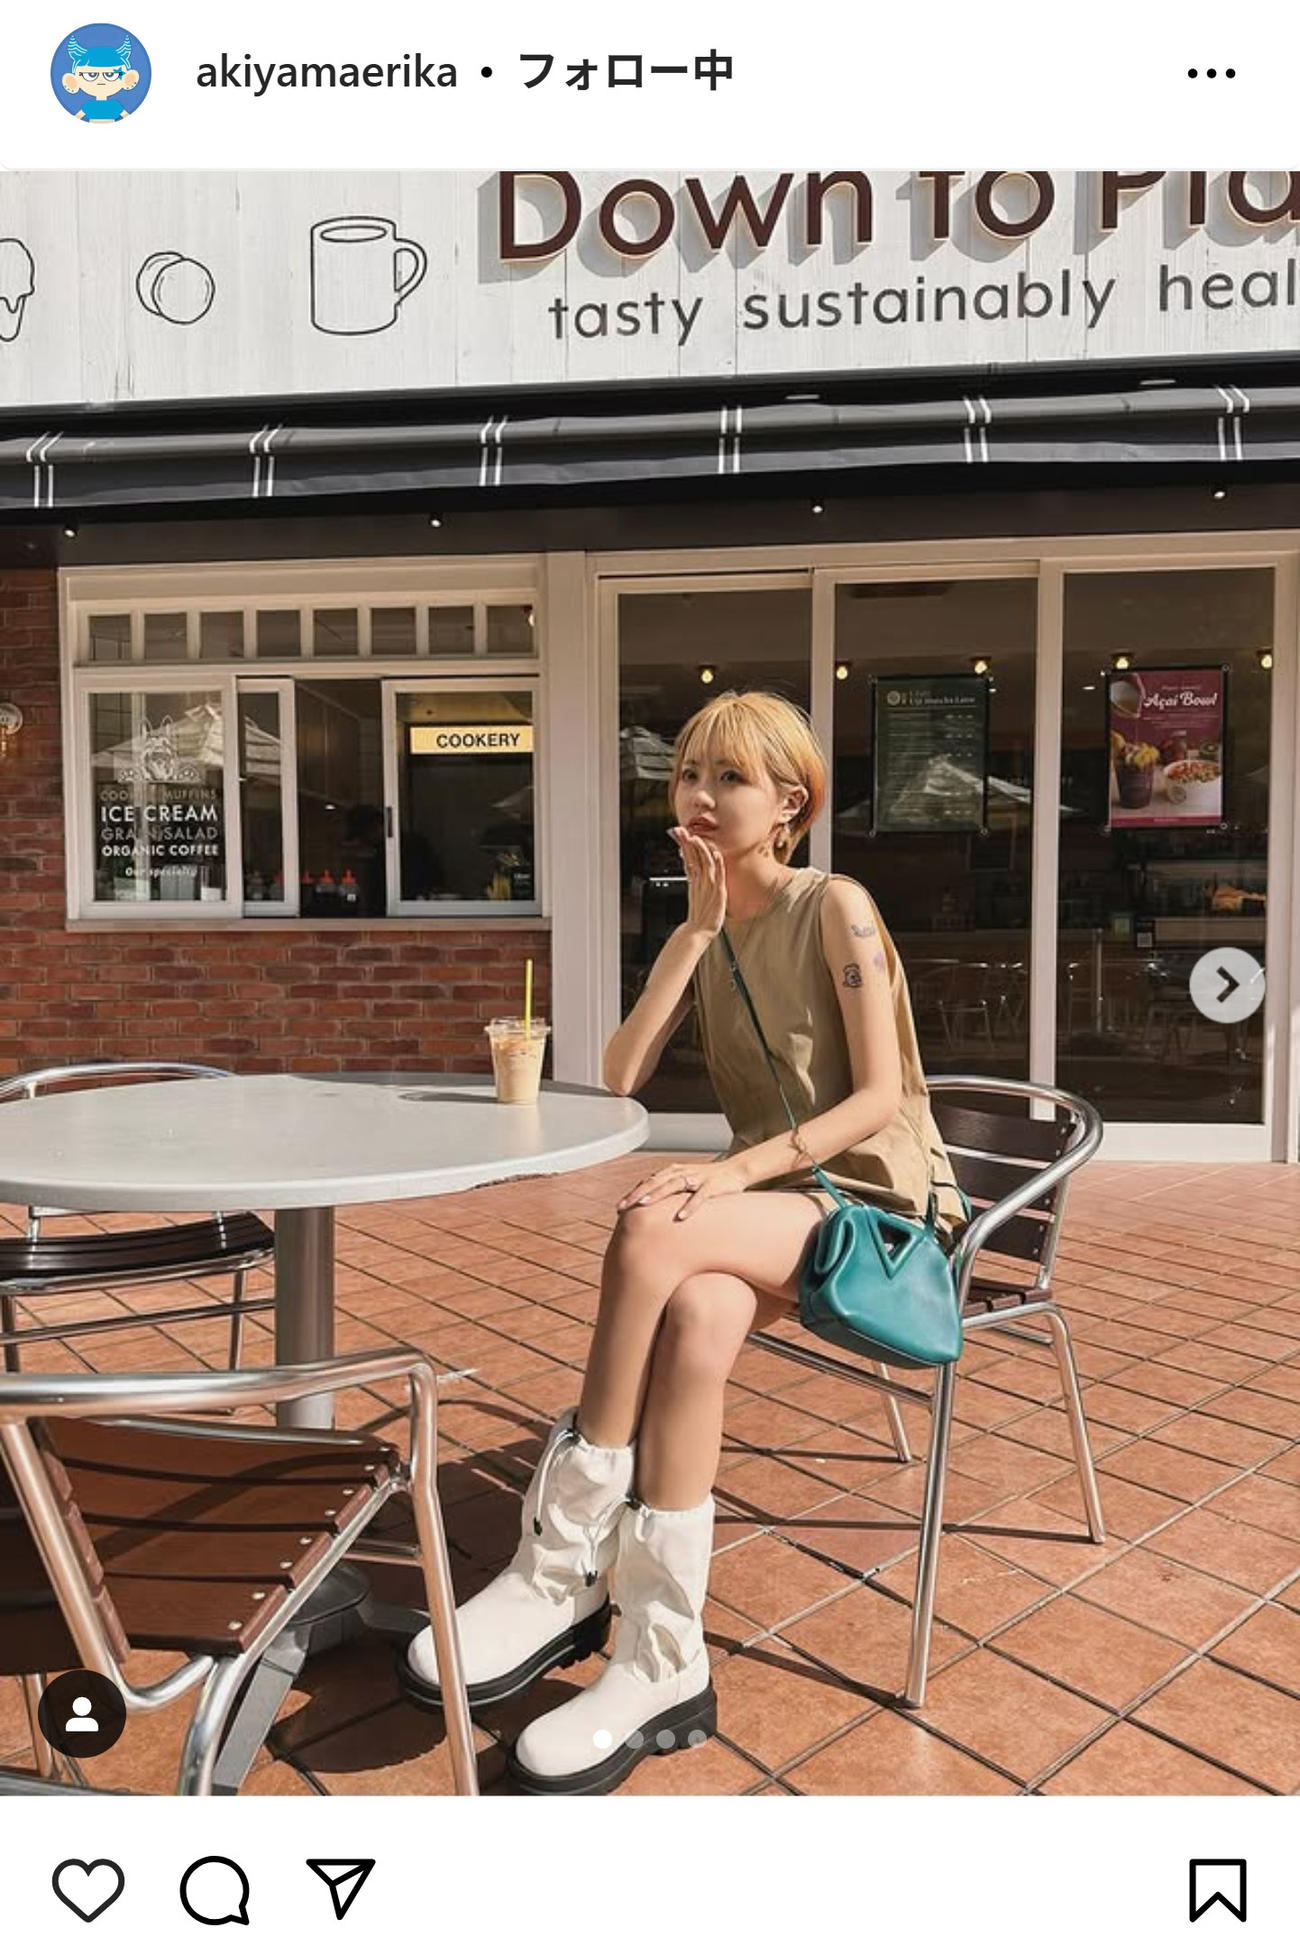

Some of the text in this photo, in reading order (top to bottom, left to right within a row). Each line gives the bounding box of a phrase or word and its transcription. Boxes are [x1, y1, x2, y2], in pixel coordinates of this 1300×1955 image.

[499, 171, 872, 259] Down
[919, 171, 1056, 239] to
[547, 258, 1296, 347] tasty sustainably heal
[435, 733, 521, 749] COOKERY
[101, 804, 218, 822] ICE CREAM
[101, 826, 218, 841] GRAN SALAD
[101, 843, 219, 857] ORGANIC COFFEE
